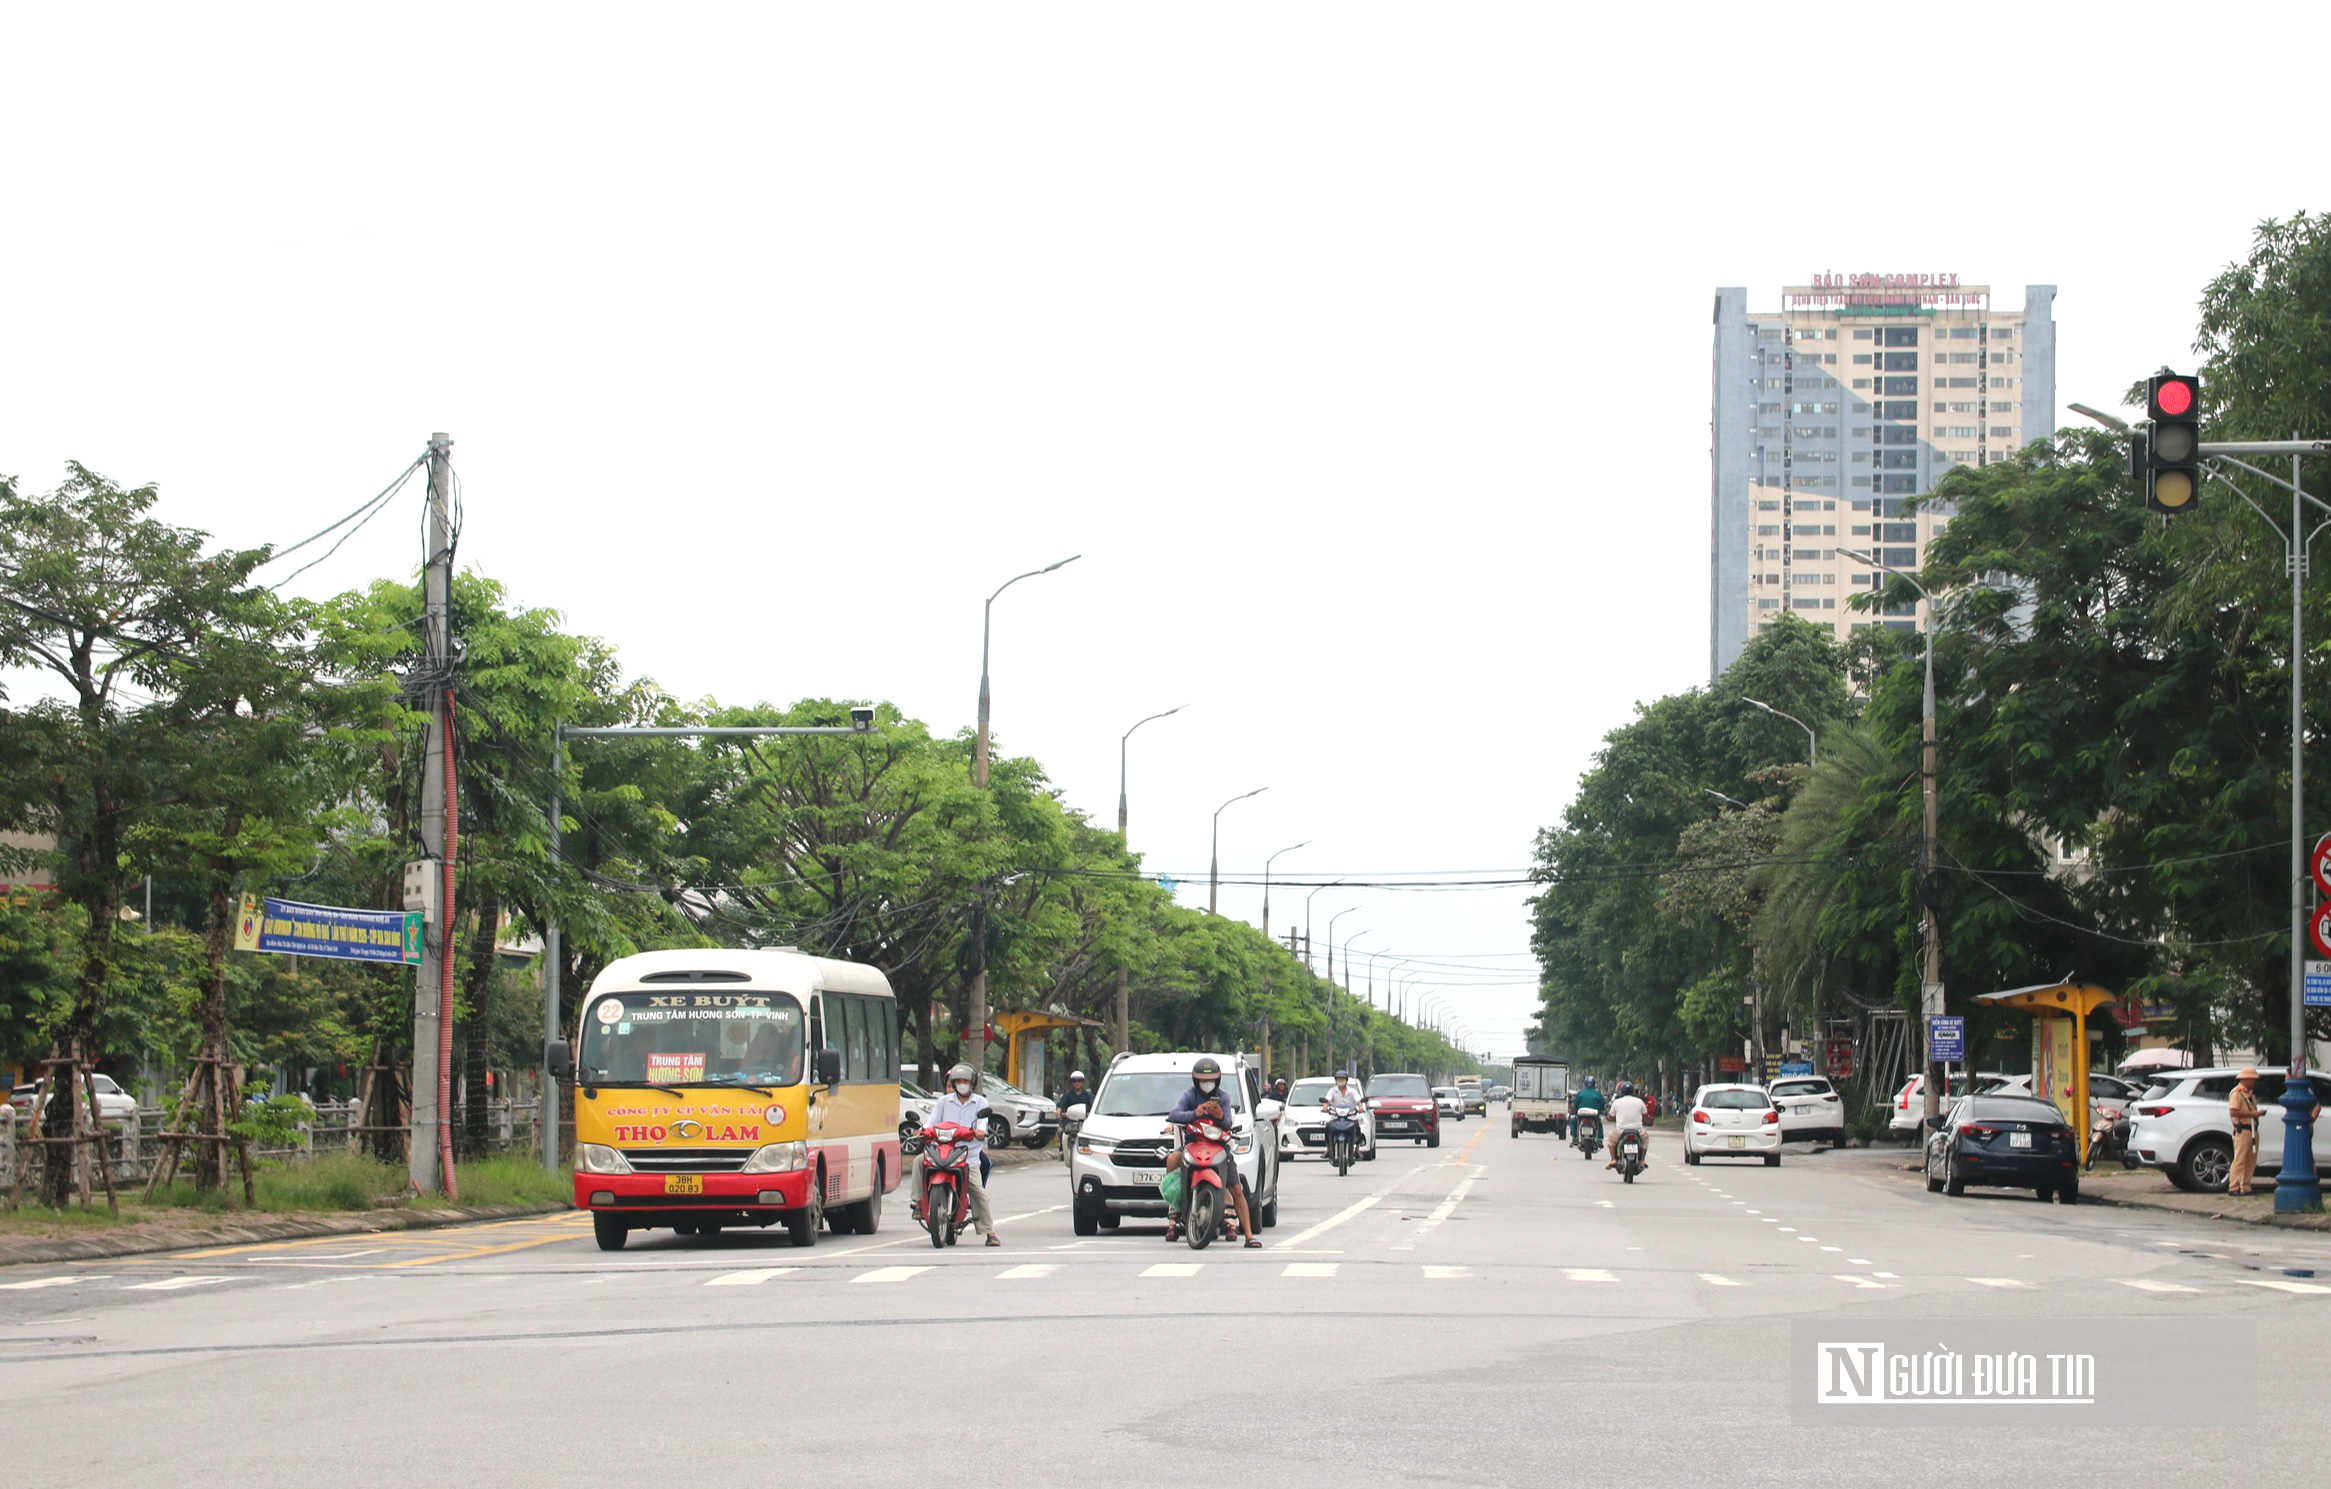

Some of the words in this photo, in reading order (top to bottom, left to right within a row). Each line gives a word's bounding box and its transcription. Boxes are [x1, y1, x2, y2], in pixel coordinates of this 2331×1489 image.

[1812, 268, 1843, 288] BẢO
[1849, 272, 1880, 288] SƠN
[1885, 273, 1959, 288] COMPLEX
[649, 996, 686, 1007] XE
[694, 993, 770, 1007] BUÝT
[602, 1004, 620, 1019] 22
[632, 1012, 663, 1021] TRUNG
[666, 1008, 686, 1019] TÂM
[689, 1010, 723, 1019] HƯƠNG
[766, 1012, 788, 1020] VINH
[652, 1056, 681, 1066] TRUNG
[683, 1055, 702, 1066] TÂM
[683, 1067, 703, 1082] SƠN
[607, 1105, 647, 1116] CÔNG
[652, 1107, 672, 1115] TY
[676, 1107, 695, 1115] CP
[700, 1103, 731, 1117] VẬN
[737, 1103, 763, 1116] TẢI
[614, 1125, 667, 1144] THỌ
[705, 1125, 760, 1141] LAM
[676, 1176, 692, 1184] 38H
[668, 1185, 699, 1194] 020.83
